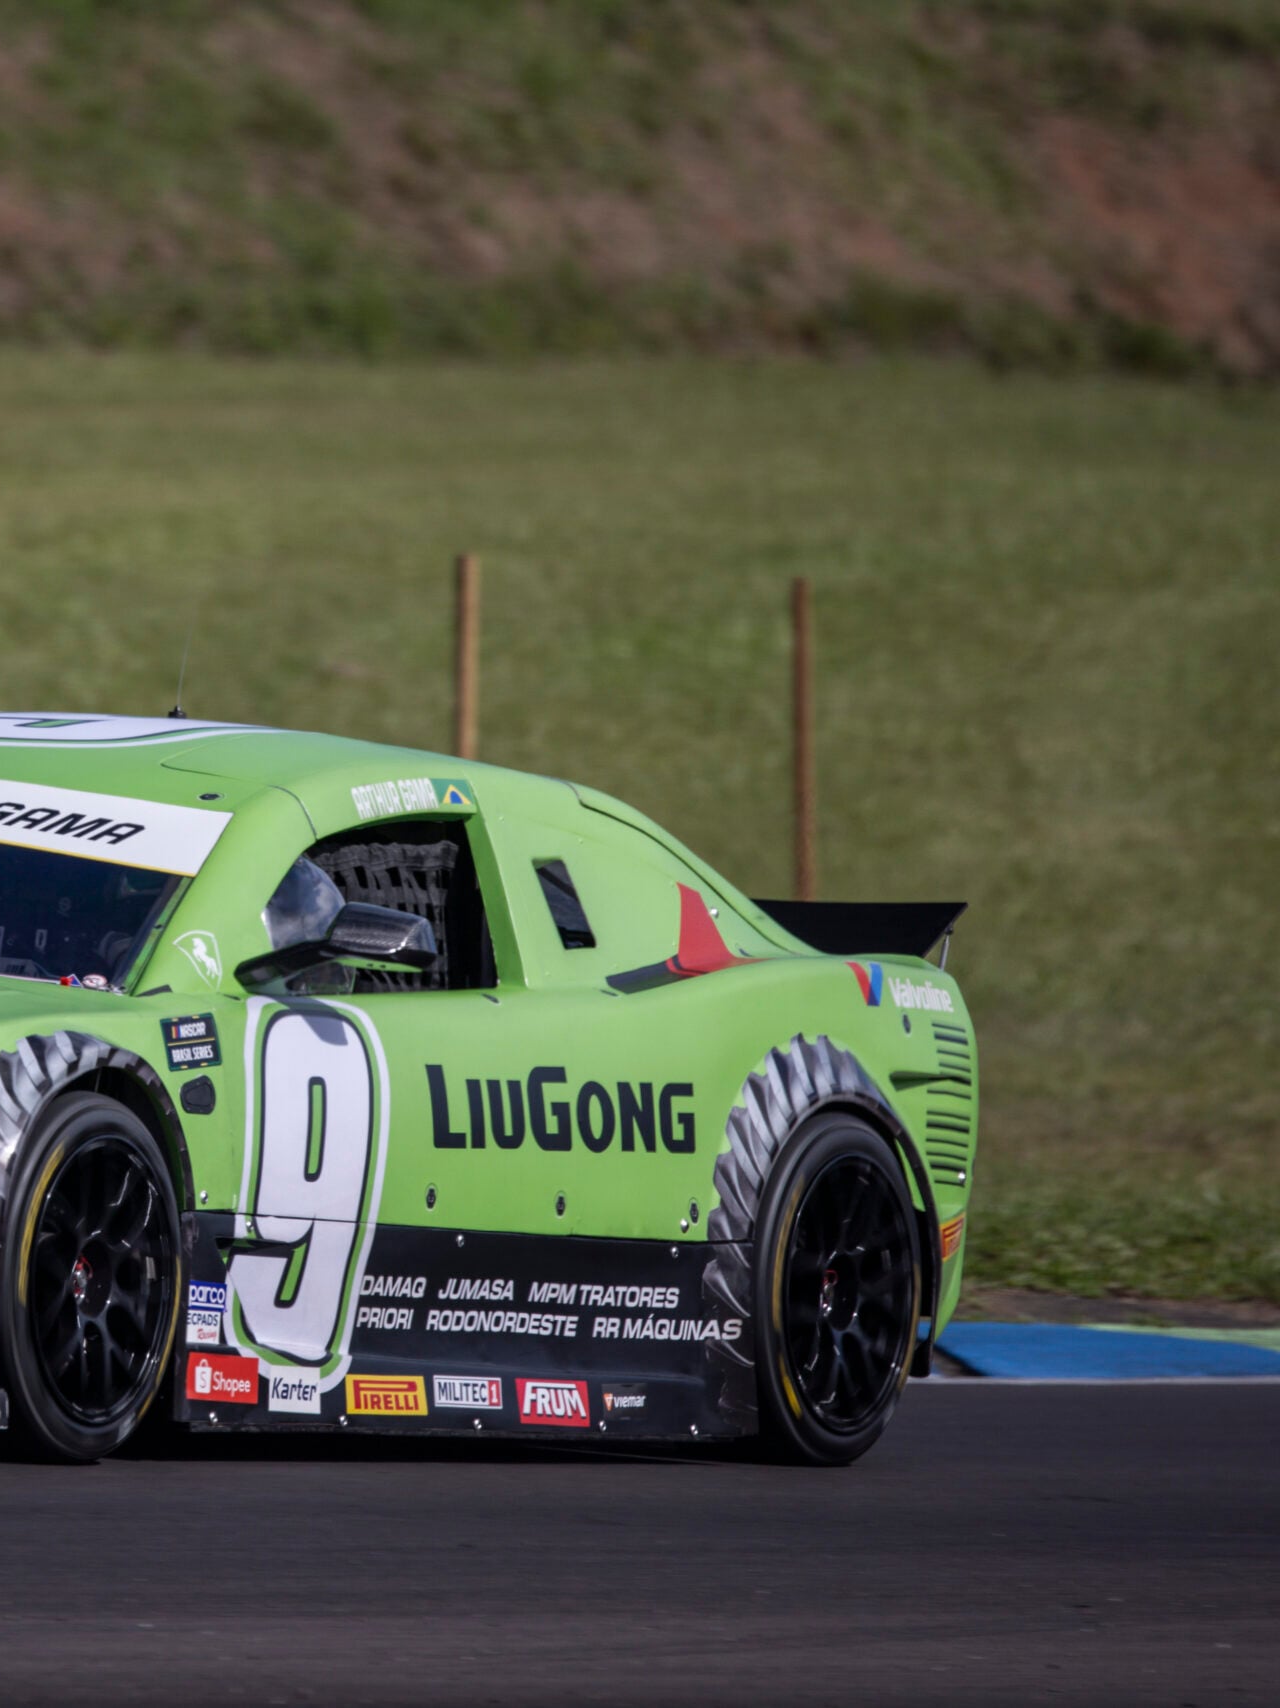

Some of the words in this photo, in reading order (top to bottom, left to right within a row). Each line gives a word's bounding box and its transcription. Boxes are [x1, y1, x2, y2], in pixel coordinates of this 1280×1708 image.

[351, 780, 403, 821] ARTHUR
[397, 777, 439, 812] GAMA
[888, 977, 954, 1012] Valvoline
[179, 1021, 207, 1038] NASCAR
[172, 1047, 193, 1063] BRASIL
[192, 1045, 214, 1061] SERIES
[224, 1008, 376, 1367] 9
[189, 1286, 226, 1304] parco
[359, 1275, 427, 1298] DAMAQ
[438, 1278, 515, 1300] JUMASA
[528, 1282, 578, 1304] MPM
[579, 1285, 680, 1309] TRATORES
[356, 1307, 414, 1330] PRIORI
[426, 1309, 579, 1337] RODONORDESTE
[592, 1316, 620, 1338] RR
[622, 1313, 743, 1341] MÁQUINAS
[213, 1371, 251, 1397] Shopee
[271, 1377, 317, 1401] Karter
[353, 1379, 419, 1411] PIRELLI
[523, 1382, 588, 1417] FRUM
